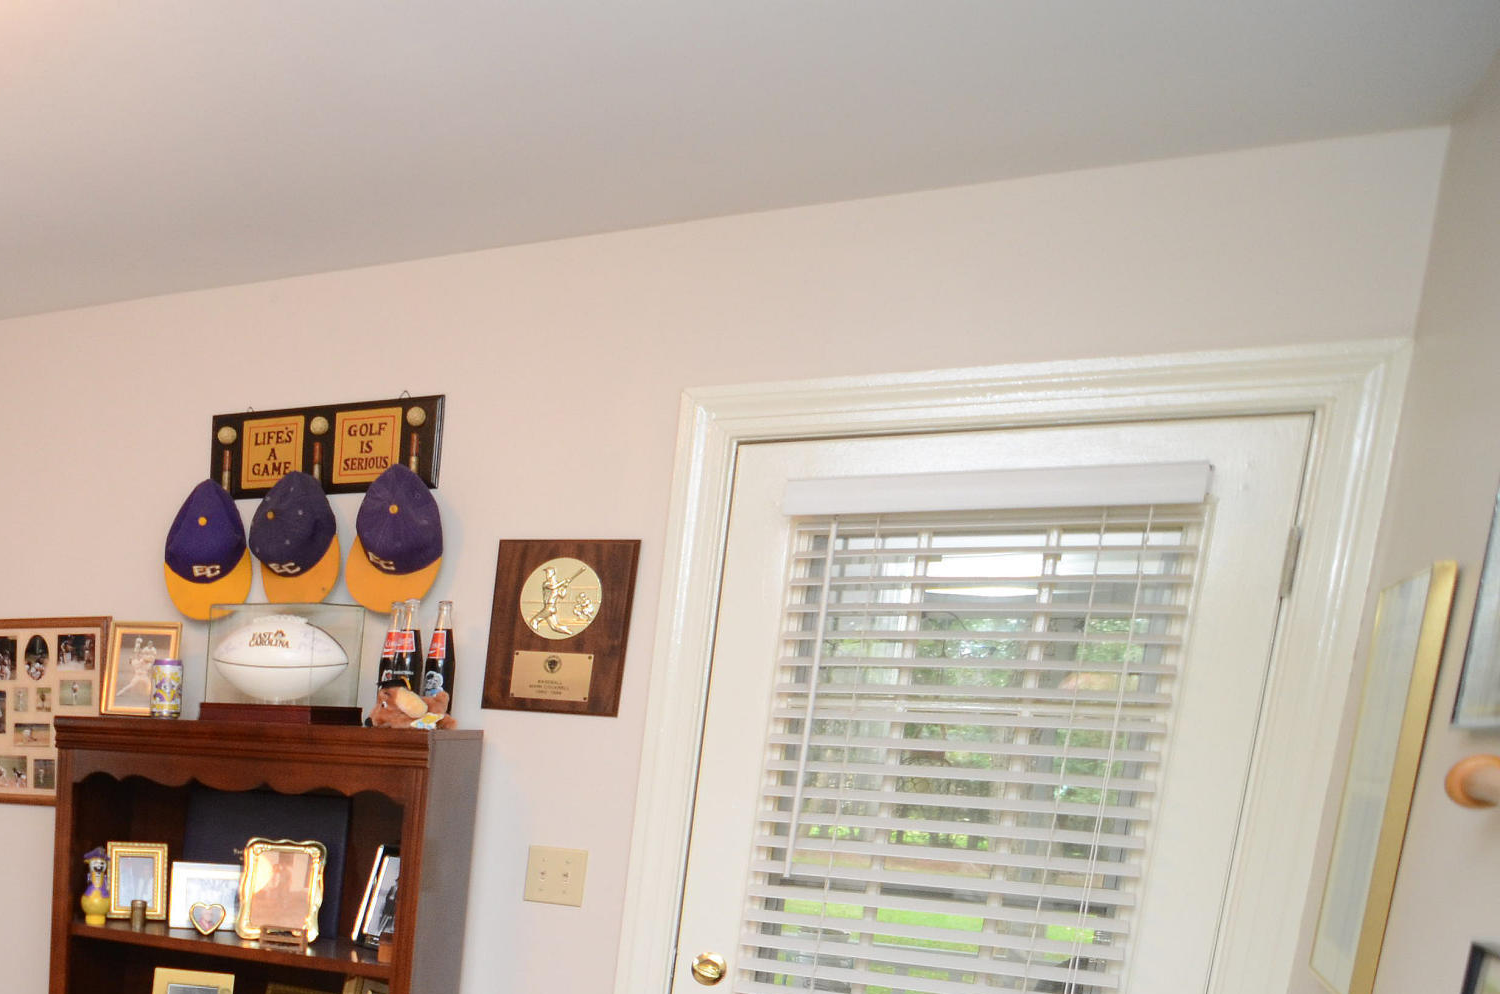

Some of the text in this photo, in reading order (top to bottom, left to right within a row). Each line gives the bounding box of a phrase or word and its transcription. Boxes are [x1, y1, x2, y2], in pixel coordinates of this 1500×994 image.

[254, 426, 294, 446] LIFE'S
[347, 422, 388, 437] GOLF
[359, 440, 373, 453] IS
[267, 448, 277, 461] A
[252, 461, 291, 476] GAME
[343, 456, 389, 471] SERIOUS
[368, 551, 396, 571] EC
[192, 564, 221, 577] EC
[268, 562, 300, 574] EC
[252, 631, 274, 641] EAST
[248, 638, 292, 648] CAROLINA
